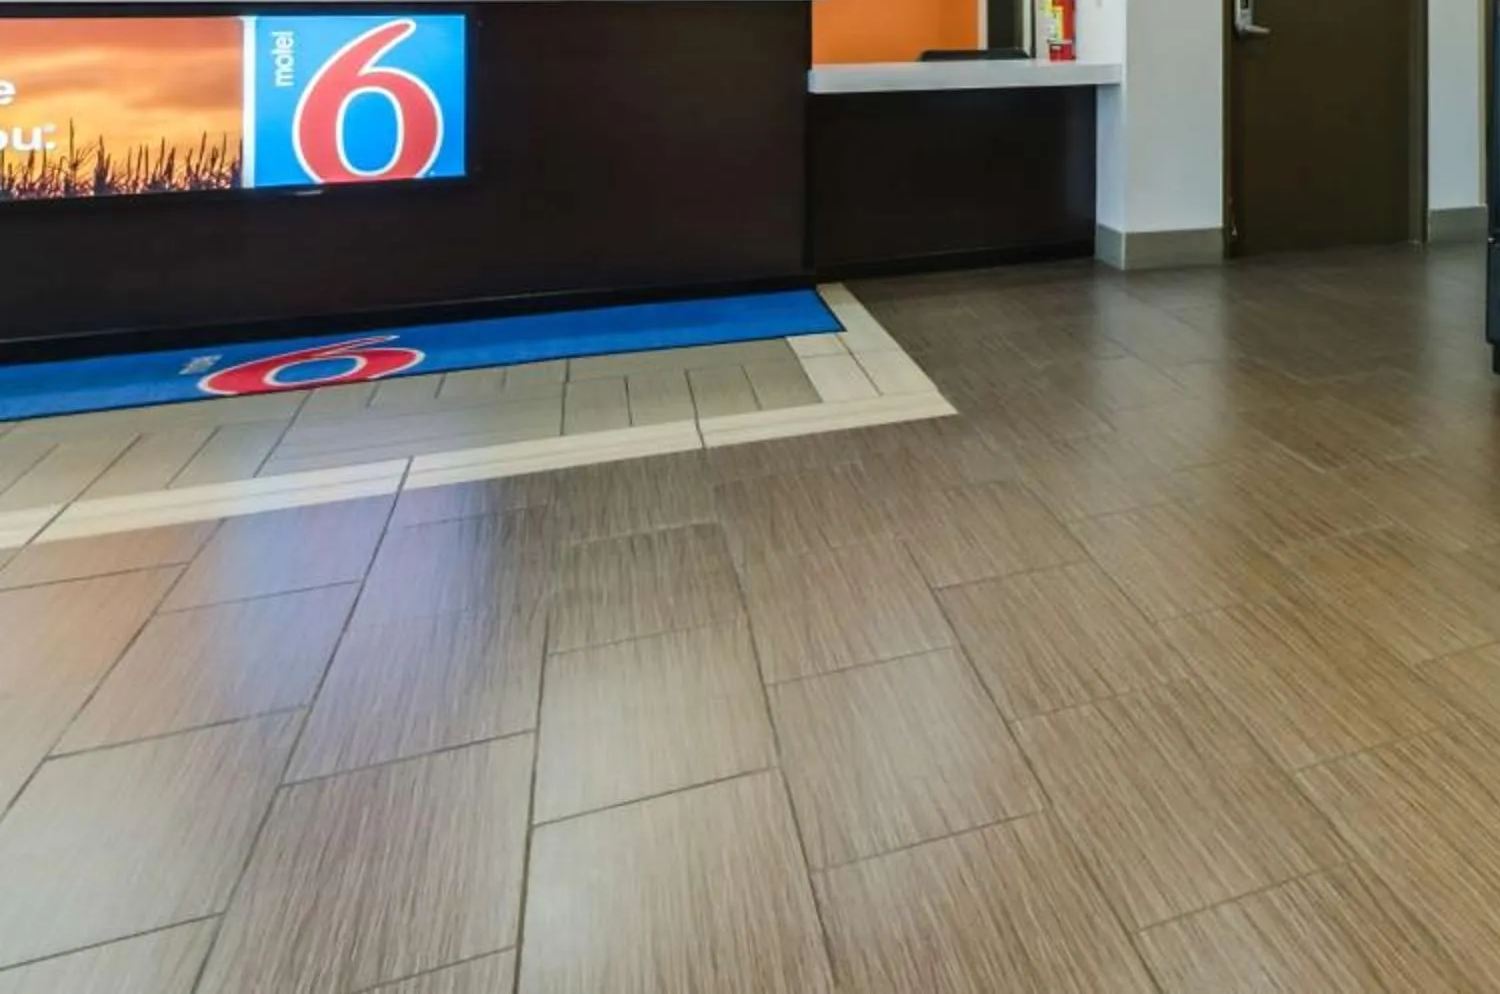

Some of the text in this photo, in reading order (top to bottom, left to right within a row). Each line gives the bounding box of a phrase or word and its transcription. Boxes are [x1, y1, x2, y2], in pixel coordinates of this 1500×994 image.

[272, 19, 444, 184] motel 6
[197, 334, 425, 395] 6
